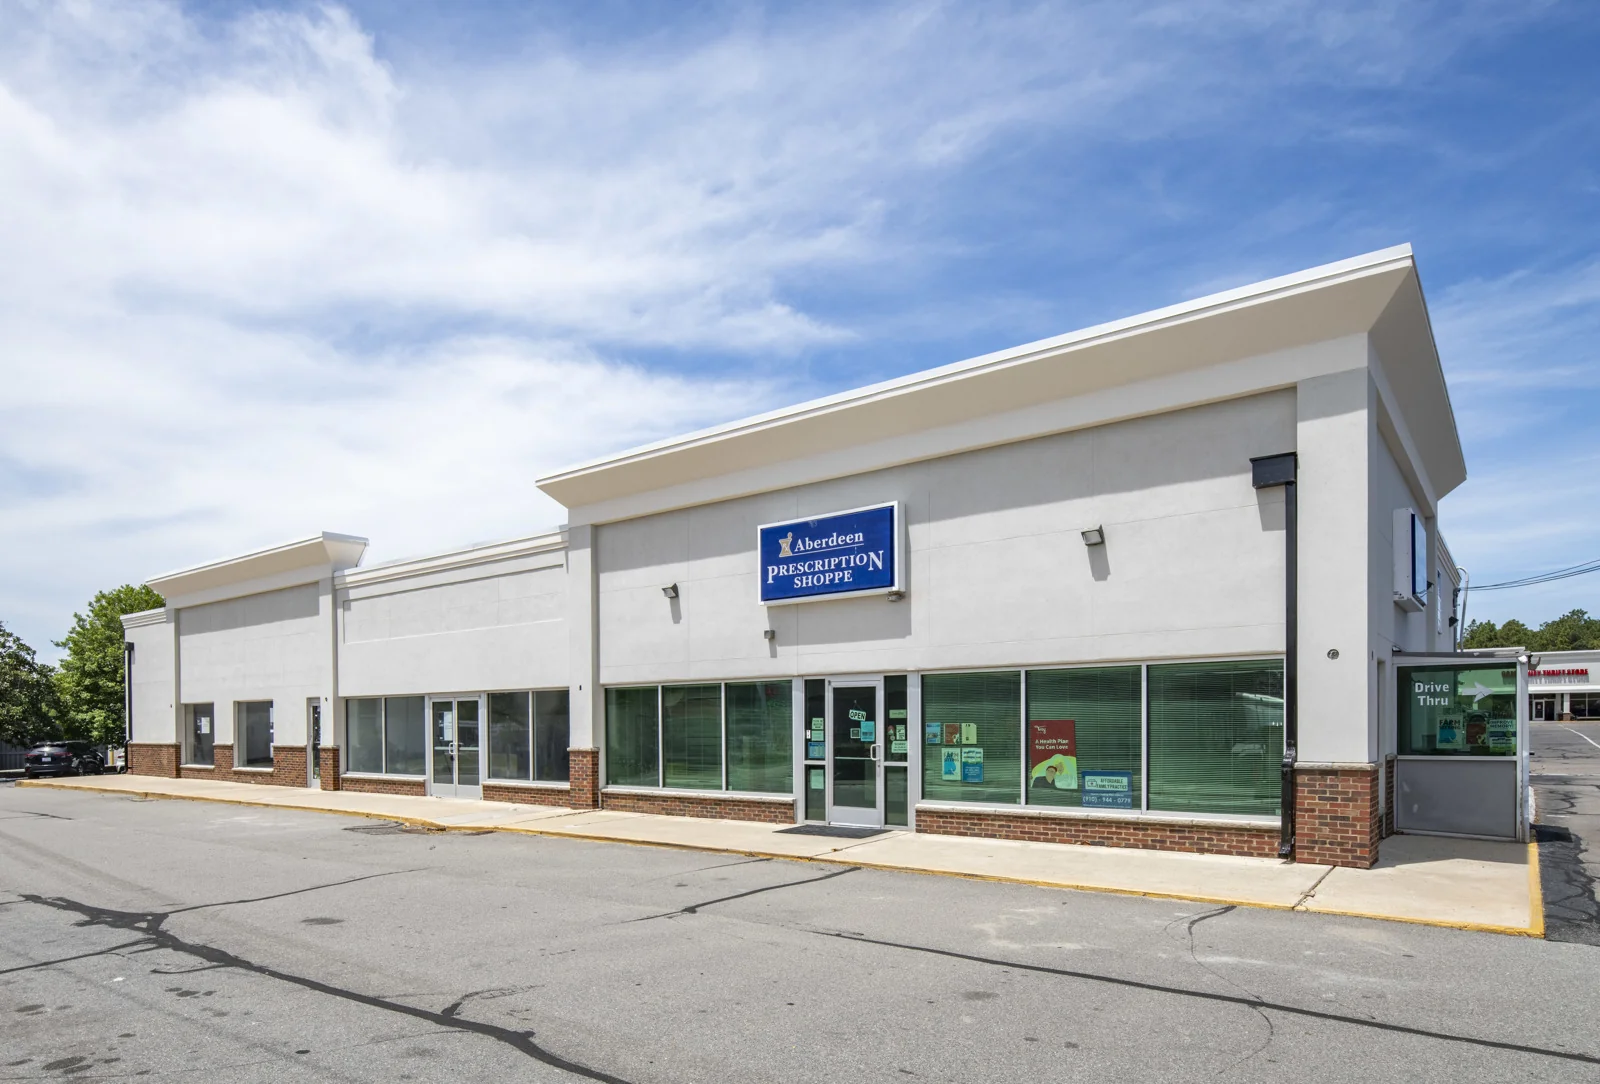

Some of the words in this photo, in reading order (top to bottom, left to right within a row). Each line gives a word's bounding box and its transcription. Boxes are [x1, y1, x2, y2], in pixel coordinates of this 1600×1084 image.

[794, 532, 864, 552] Aberdeen
[767, 550, 884, 584] PRESCRIPTION
[793, 570, 853, 588] SHOPPE
[1414, 682, 1450, 693] Drive
[1417, 696, 1449, 706] Thru
[850, 711, 866, 720] OPEN
